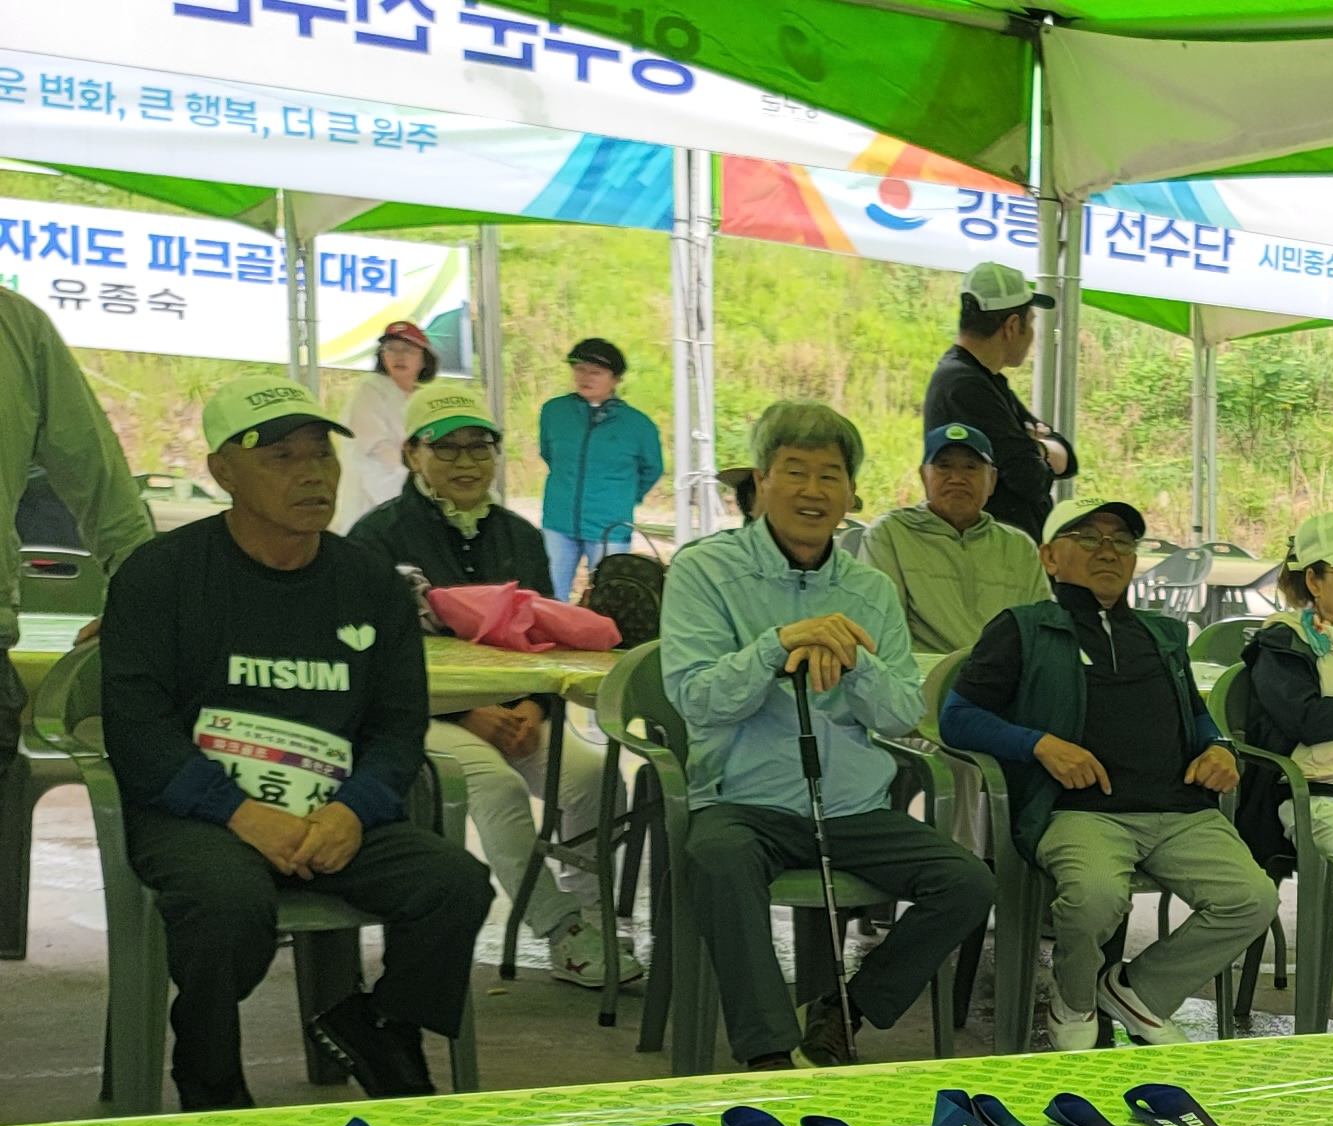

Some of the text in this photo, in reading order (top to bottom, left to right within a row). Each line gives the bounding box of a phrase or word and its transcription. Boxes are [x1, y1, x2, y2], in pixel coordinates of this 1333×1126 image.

[40, 72, 126, 121] 변화,
[139, 86, 174, 123] 큰
[186, 91, 269, 139] 행복,
[282, 106, 314, 140] 더
[327, 112, 361, 145] 큰
[372, 118, 439, 154] 원주
[1106, 211, 1235, 274] 선수단
[319, 252, 399, 297] 대회
[228, 655, 350, 691] FITSUM
